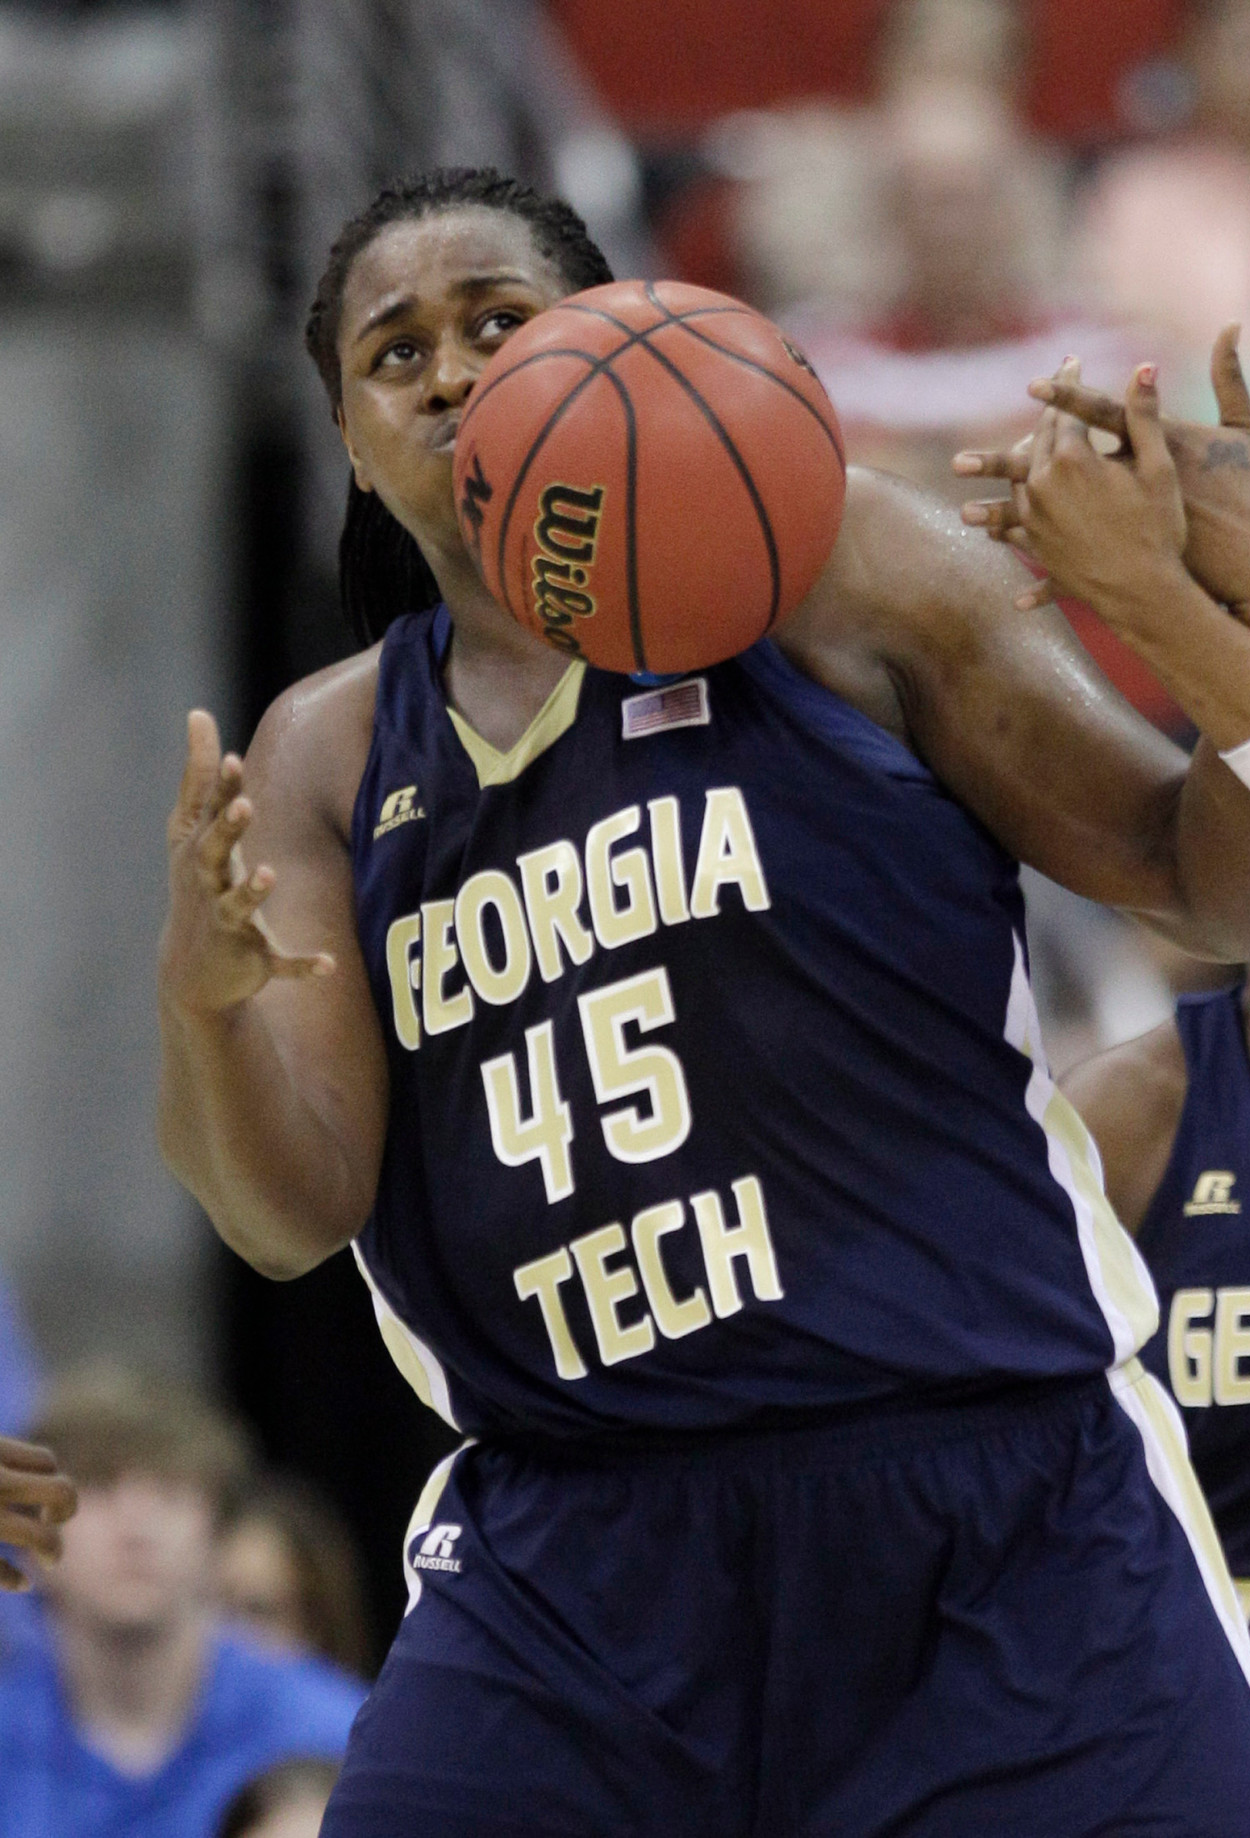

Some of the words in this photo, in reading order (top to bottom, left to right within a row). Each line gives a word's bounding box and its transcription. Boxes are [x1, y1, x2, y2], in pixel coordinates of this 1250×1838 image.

[531, 482, 605, 661] Wilso
[380, 785, 417, 823] R
[385, 785, 771, 1051] GEORGIA
[480, 966, 693, 1205] 45
[513, 1175, 784, 1381] TECH
[413, 1553, 462, 1573] RUSSELL
[420, 1523, 463, 1559] R
